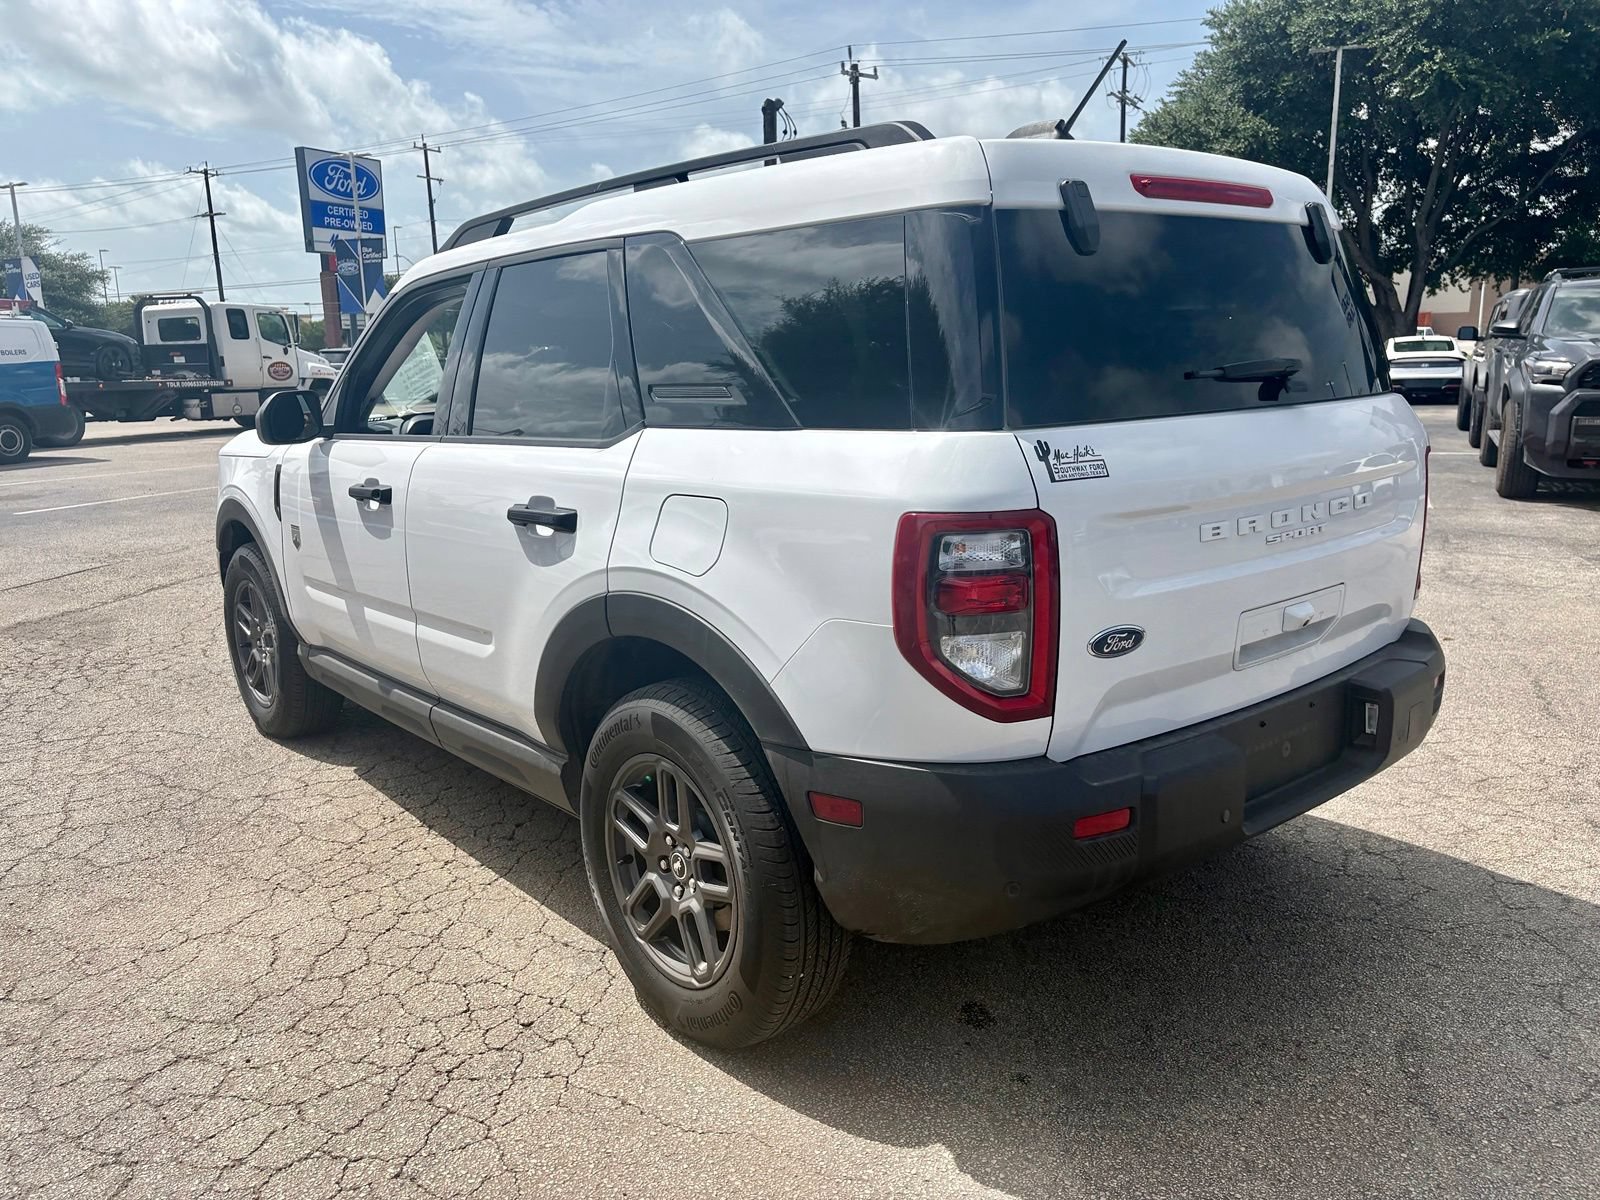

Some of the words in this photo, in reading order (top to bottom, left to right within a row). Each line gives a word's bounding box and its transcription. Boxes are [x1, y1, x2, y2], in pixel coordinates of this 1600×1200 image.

[324, 164, 367, 196] Ford
[327, 205, 369, 219] CERTIFED
[25, 272, 40, 280] USED
[26, 280, 41, 289] CARS
[1052, 448, 1073, 466] Mac
[1053, 463, 1088, 474] SOUTHWAY
[1088, 463, 1105, 471] FORD
[1200, 491, 1373, 543] BRONCO
[1265, 523, 1327, 545] SPORT
[1103, 632, 1136, 653] Ford
[589, 713, 633, 769] Continental
[682, 990, 743, 1032] Continental
